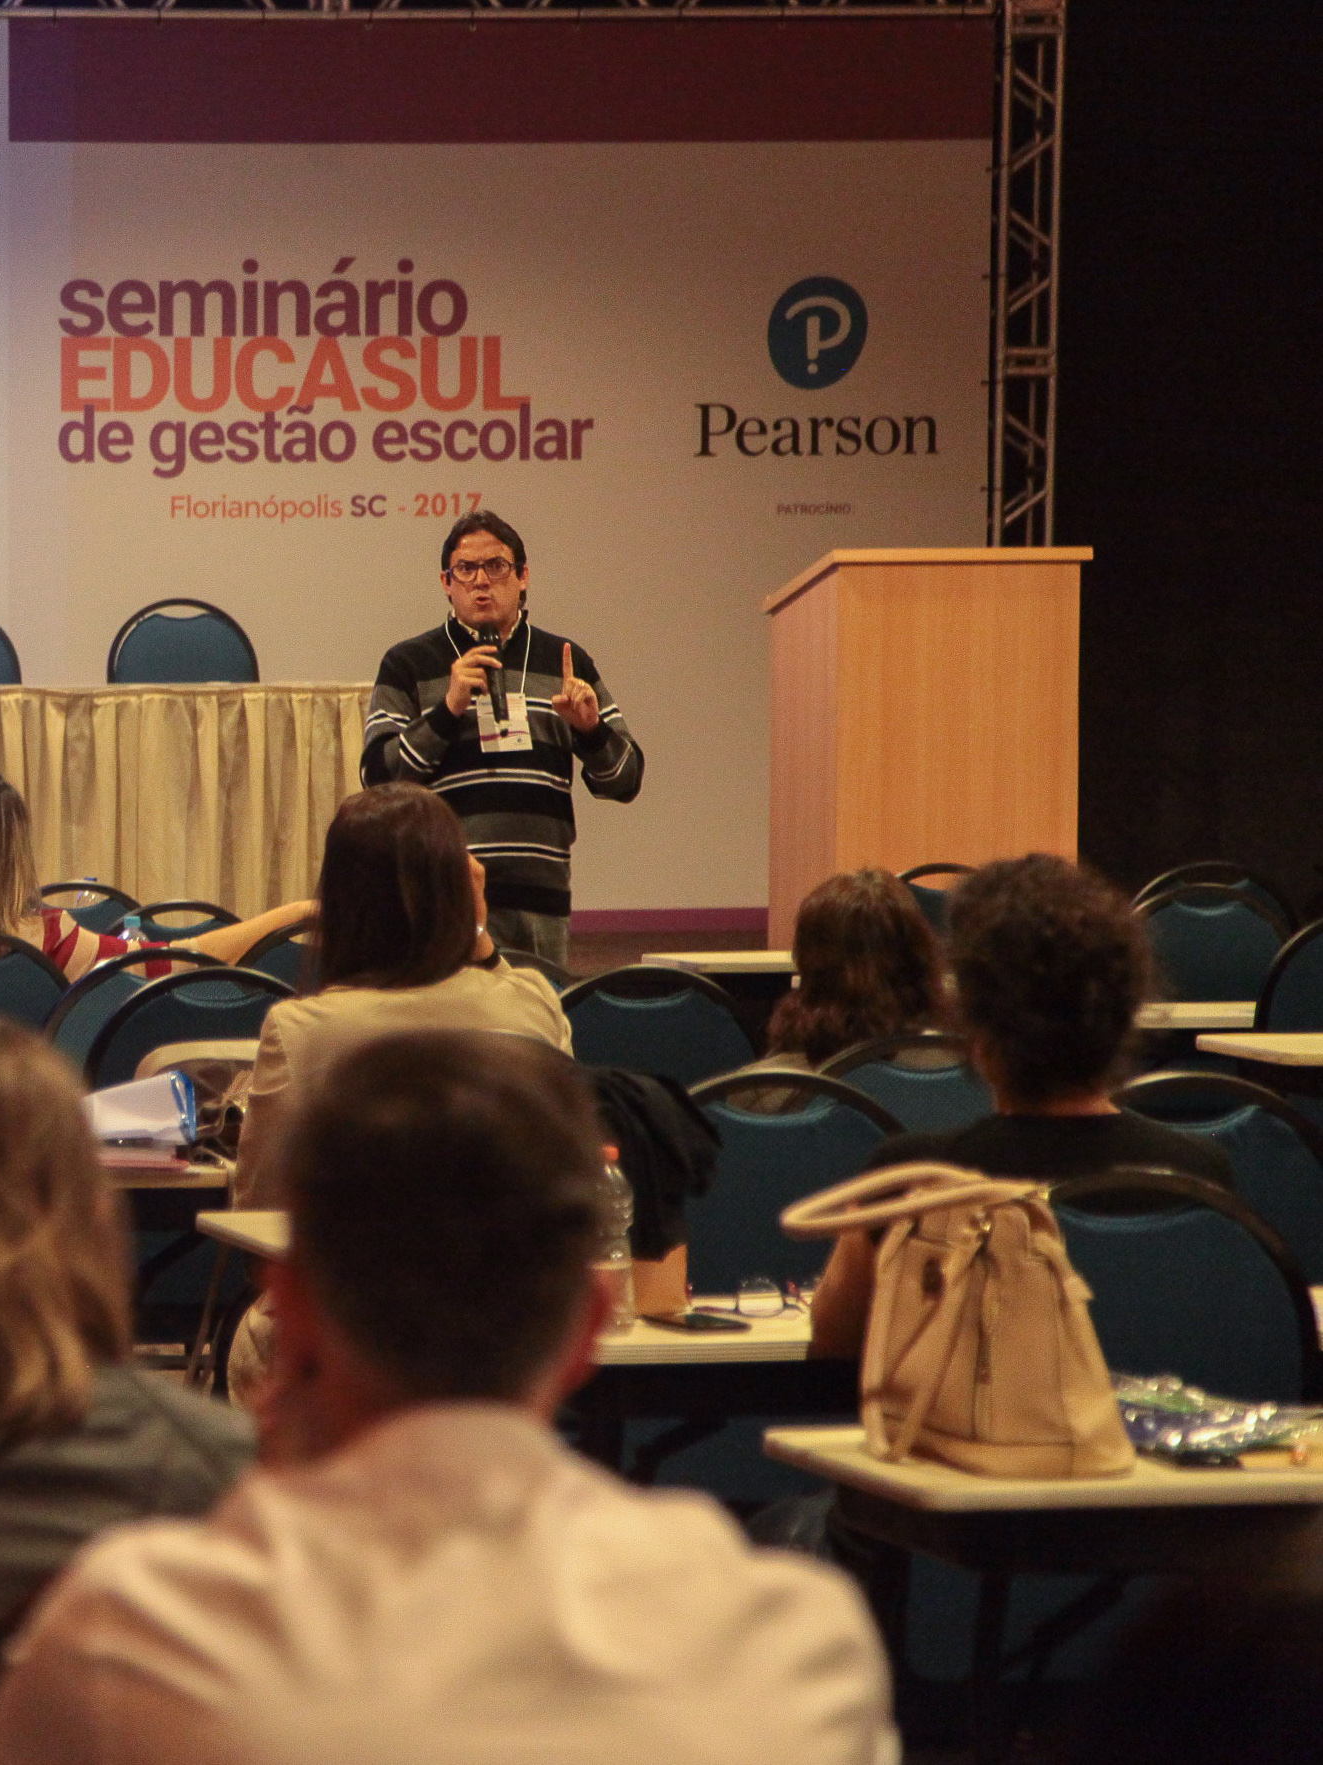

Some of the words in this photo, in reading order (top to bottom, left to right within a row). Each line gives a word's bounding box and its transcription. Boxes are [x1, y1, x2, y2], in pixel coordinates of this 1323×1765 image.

[58, 257, 468, 338] seminário
[60, 336, 532, 412] EDUCASUL
[58, 403, 134, 463] de
[150, 404, 356, 479] gestão
[372, 401, 594, 462] escolar
[694, 402, 939, 457] Pearson
[170, 494, 344, 523] Florianópolis
[350, 494, 387, 517] SC
[414, 492, 482, 517] 2017
